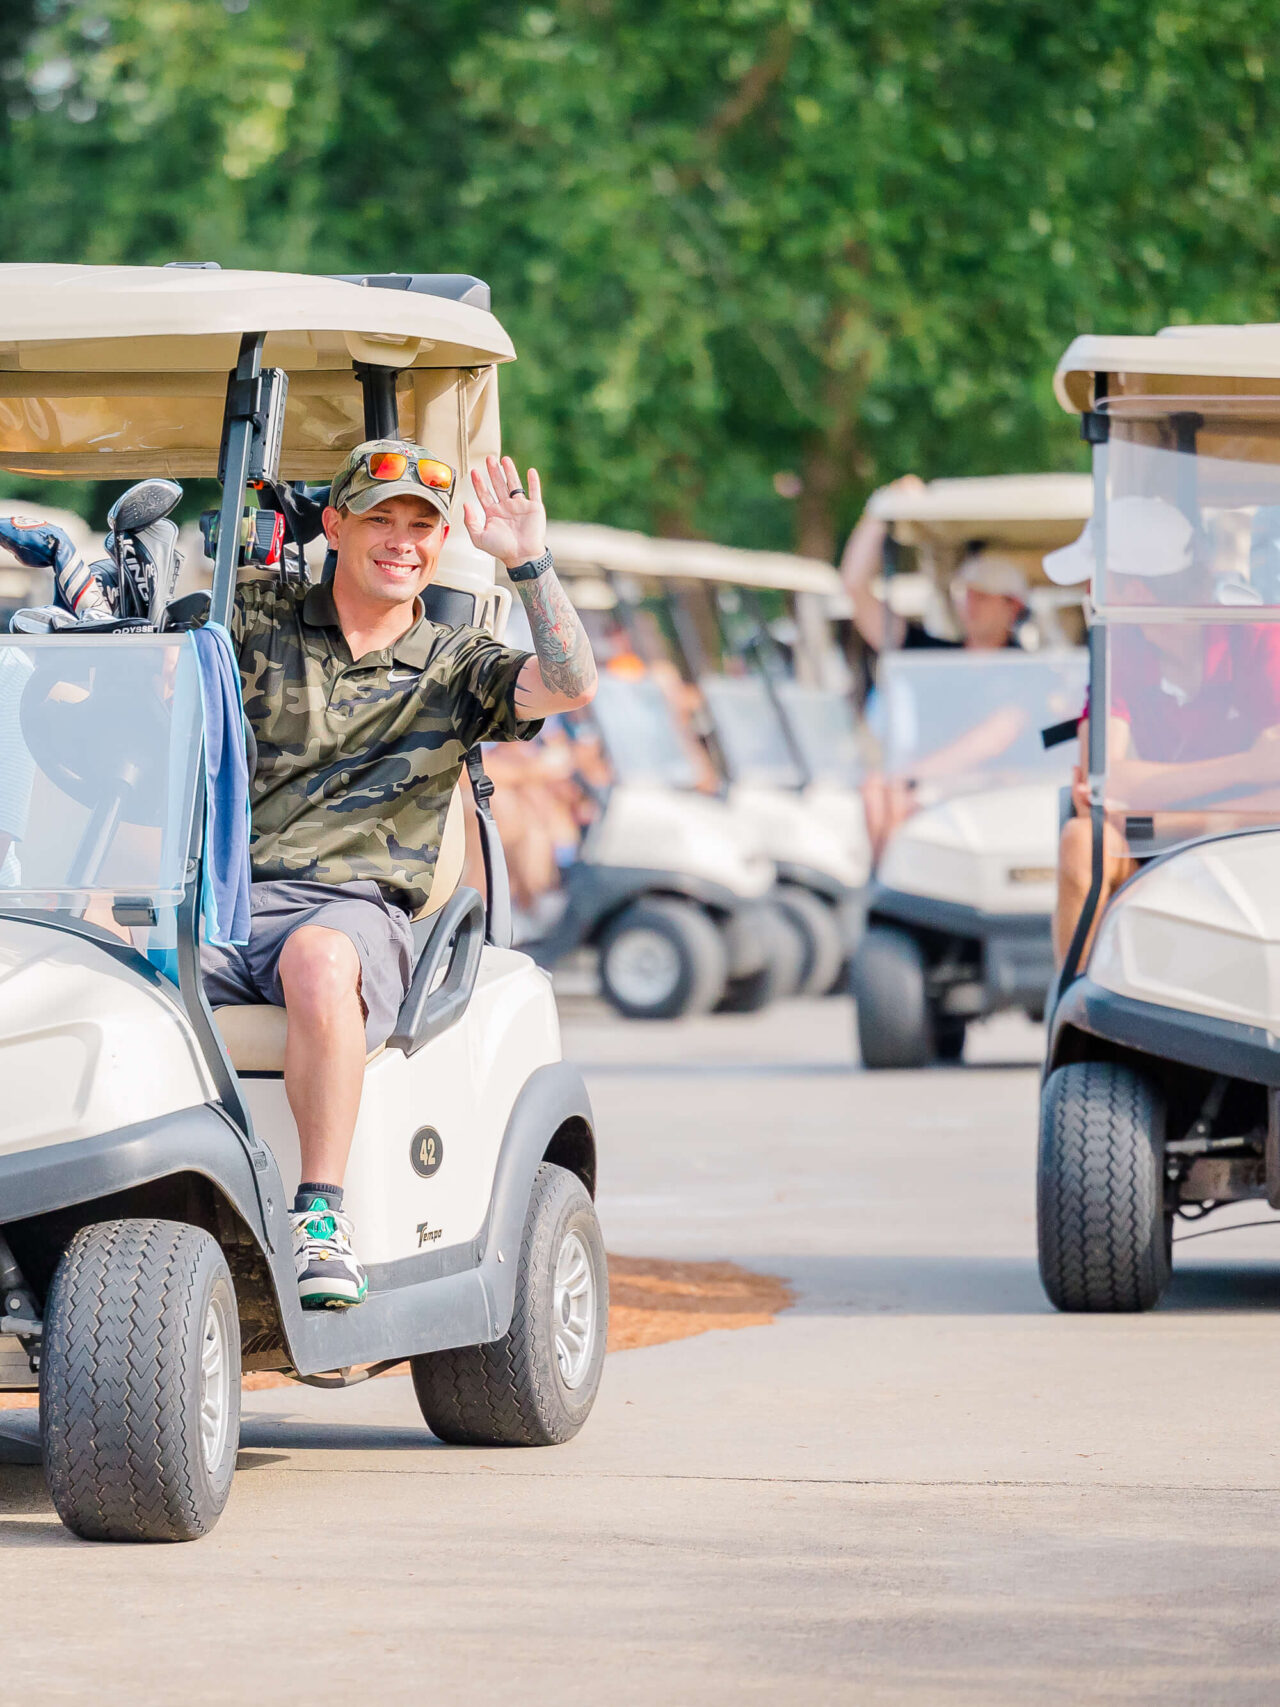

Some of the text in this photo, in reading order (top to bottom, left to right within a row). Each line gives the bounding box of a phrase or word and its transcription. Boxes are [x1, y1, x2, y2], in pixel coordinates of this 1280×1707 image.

[122, 539, 150, 602] KING
[420, 1138, 436, 1166] 42
[416, 1221, 443, 1248] Tempo
